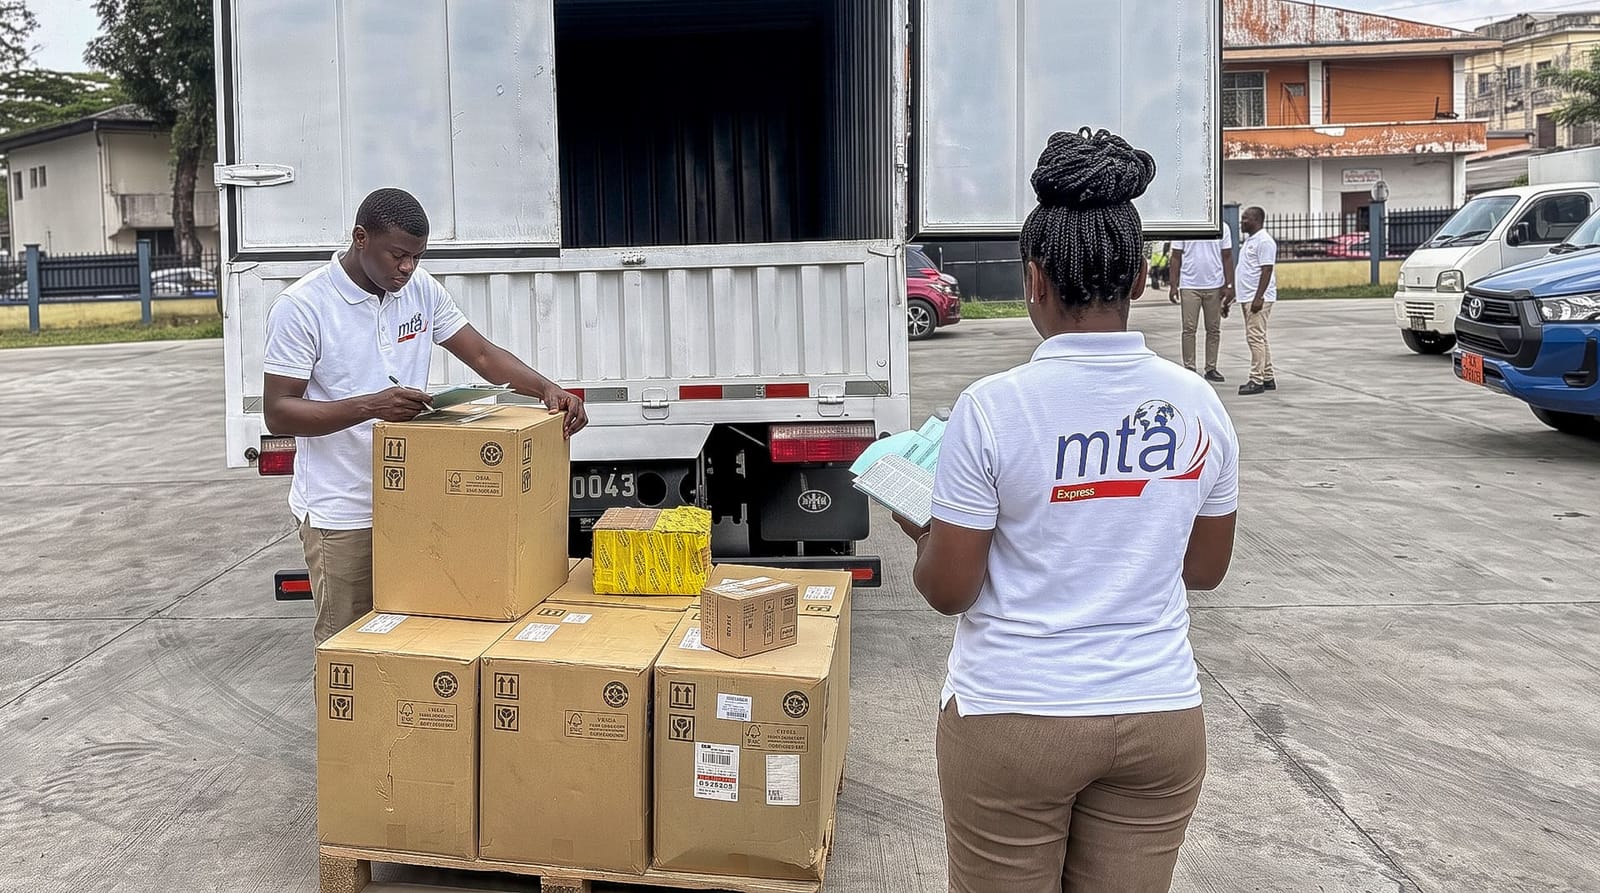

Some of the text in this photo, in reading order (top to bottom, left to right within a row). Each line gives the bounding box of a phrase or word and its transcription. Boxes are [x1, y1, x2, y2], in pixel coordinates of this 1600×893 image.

[398, 317, 422, 337] mta
[1055, 415, 1177, 480] mta
[572, 473, 635, 499] 0043
[1057, 488, 1095, 500] Express
